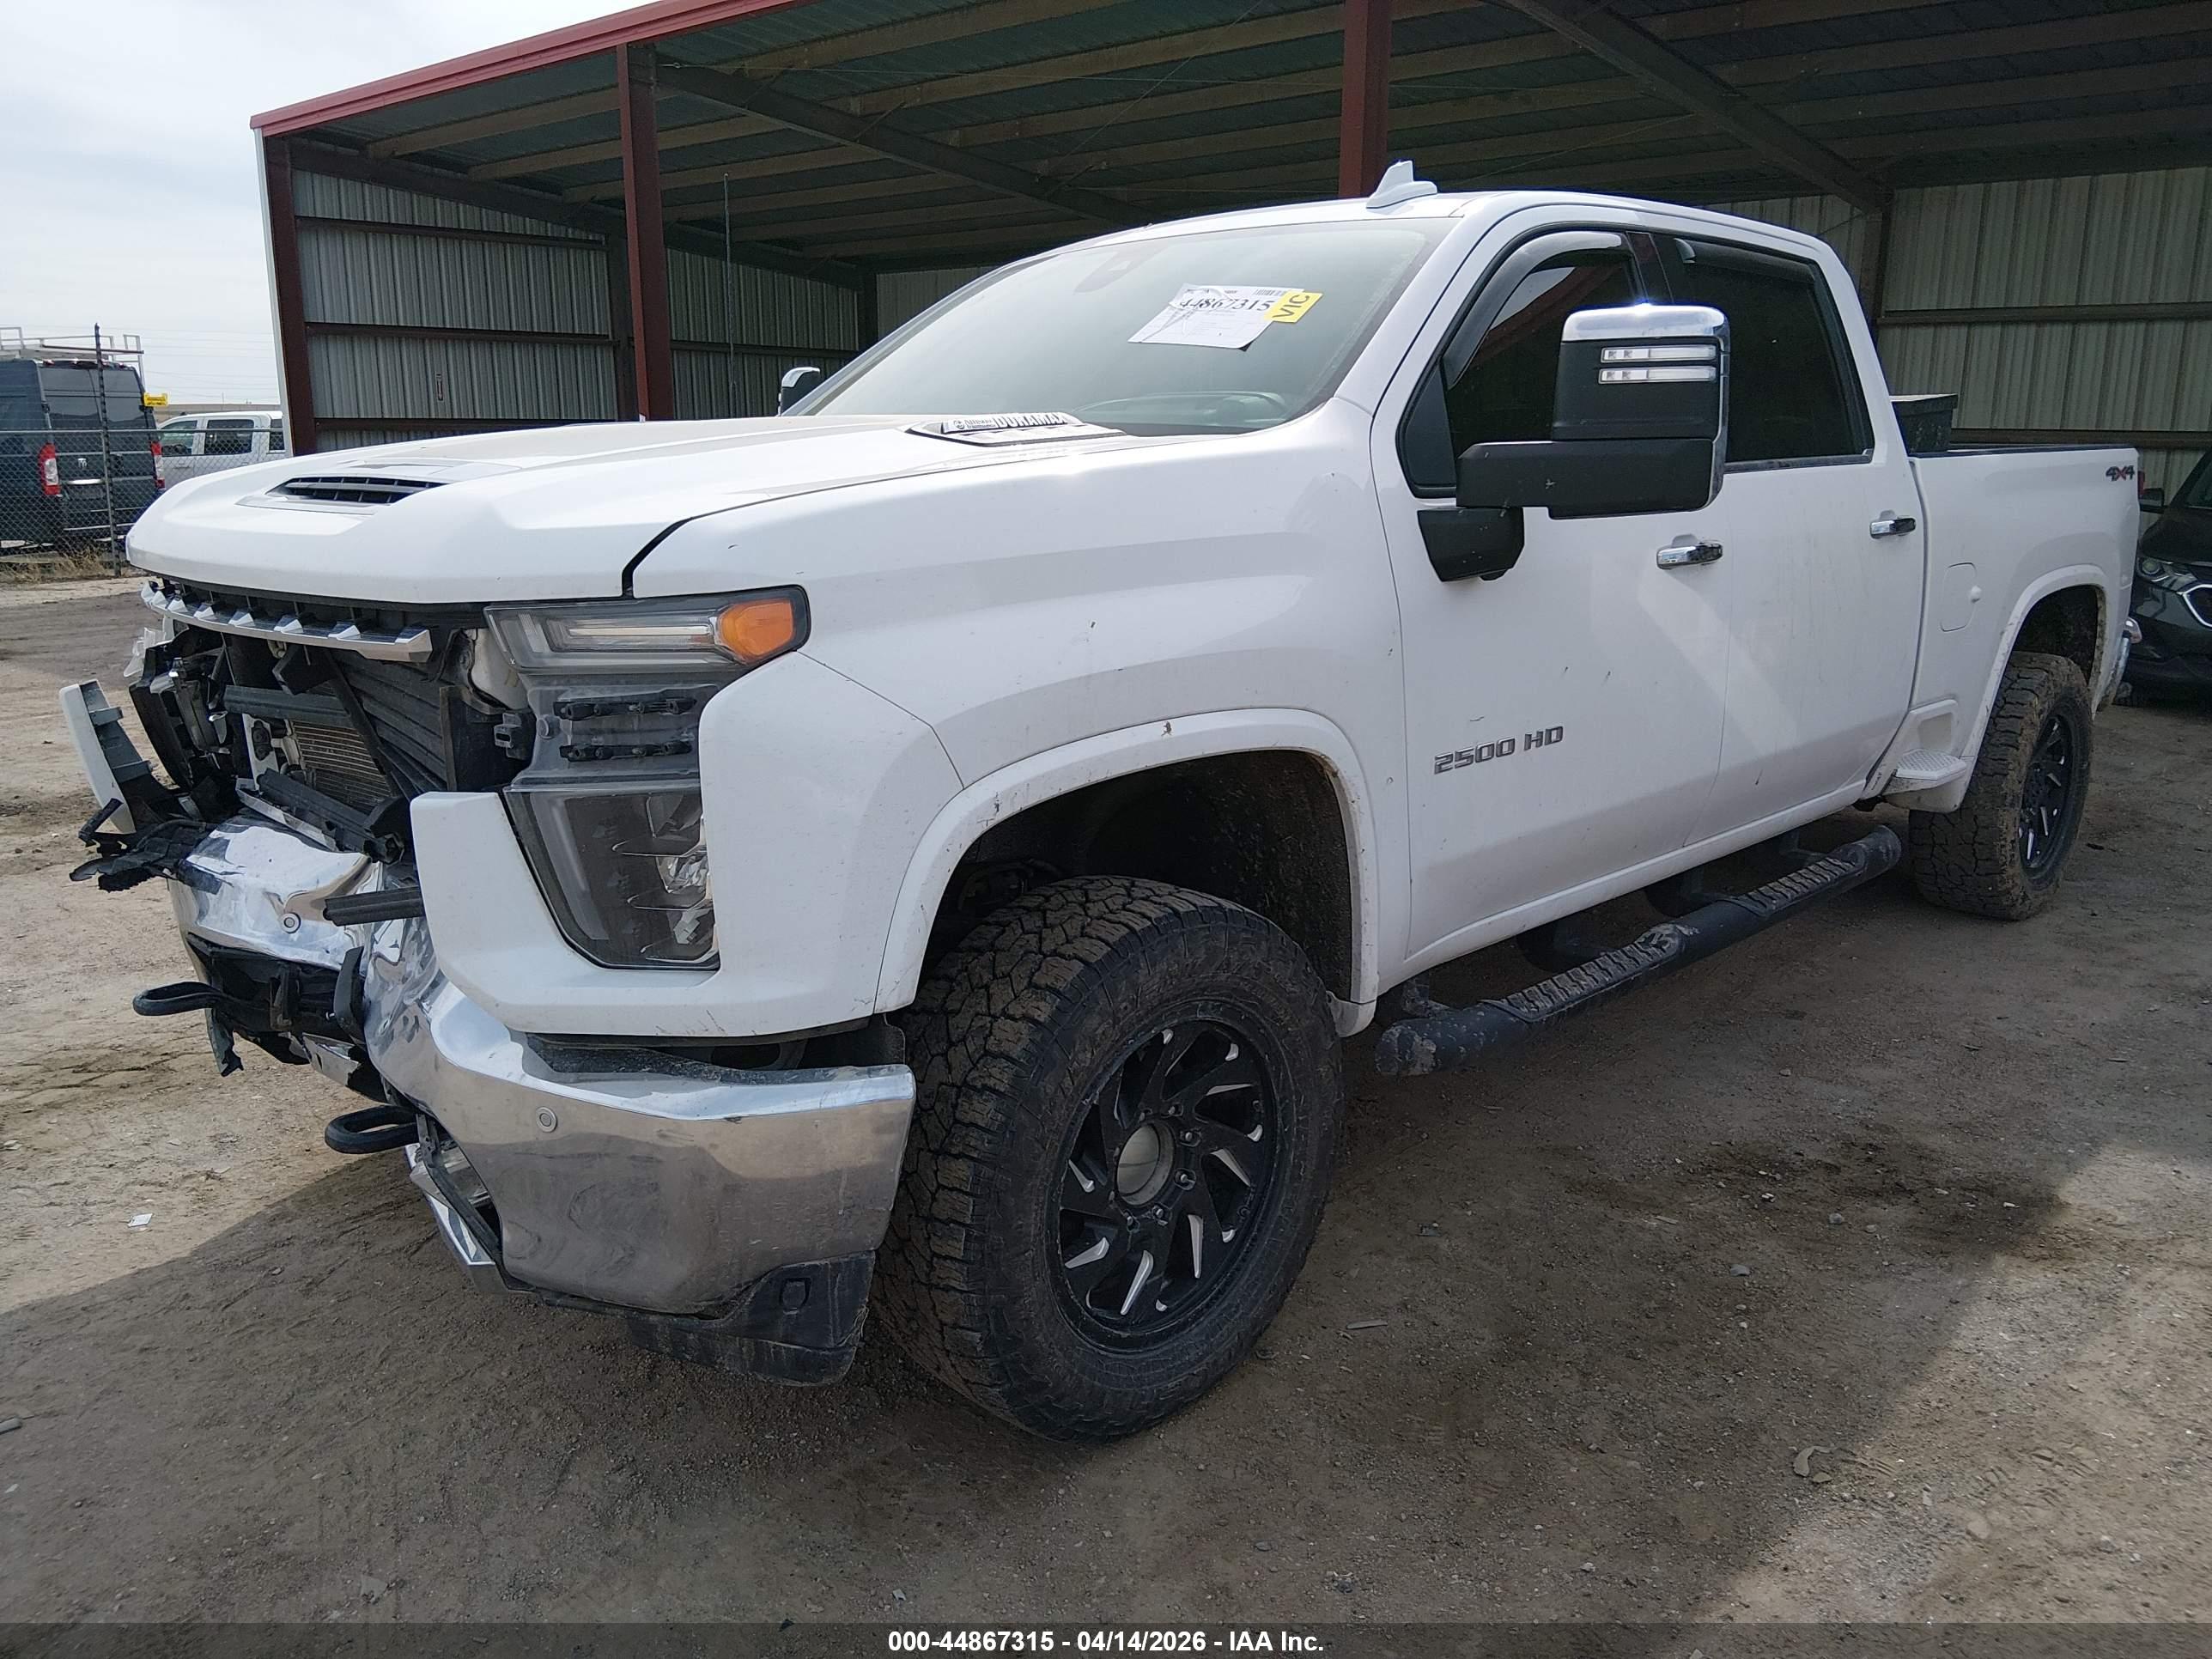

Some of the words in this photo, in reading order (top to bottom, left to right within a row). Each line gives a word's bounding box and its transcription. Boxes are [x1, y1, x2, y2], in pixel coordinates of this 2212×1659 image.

[1180, 298, 1275, 311] 44867315
[1272, 294, 1310, 319] VIC
[994, 413, 1066, 428] DURAMAX
[1434, 737, 1516, 775] 2500
[1523, 726, 1564, 751] HD
